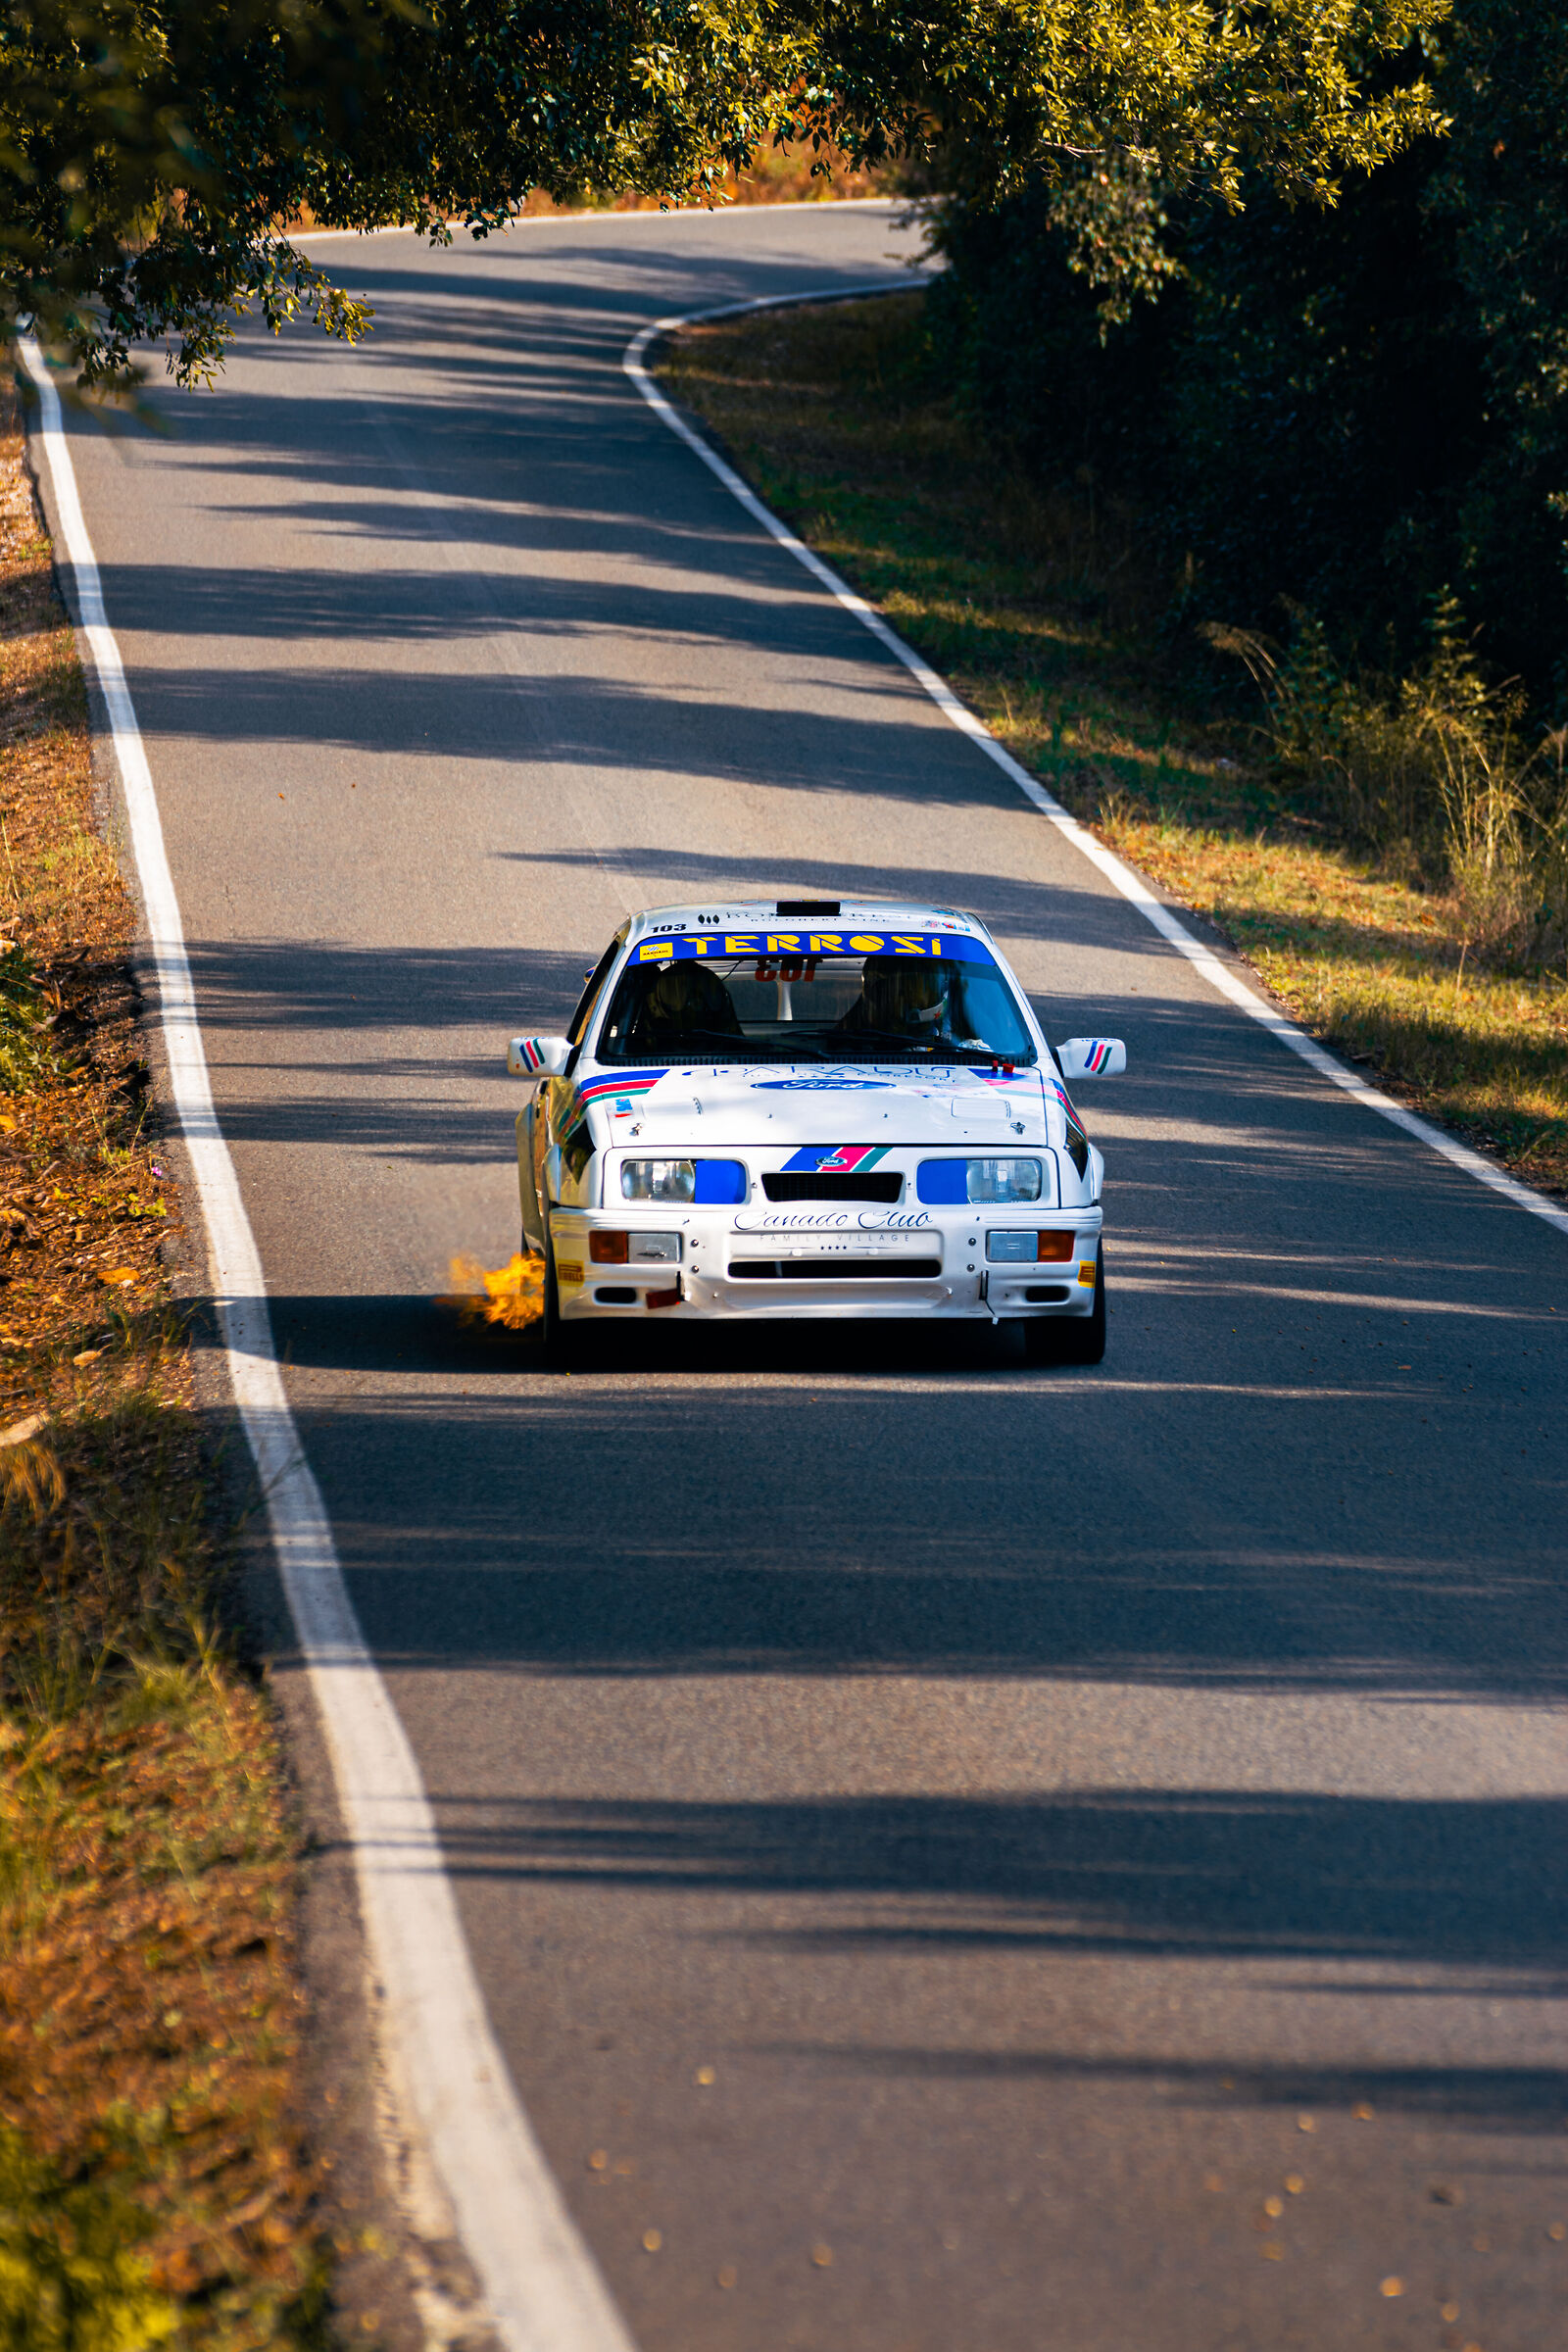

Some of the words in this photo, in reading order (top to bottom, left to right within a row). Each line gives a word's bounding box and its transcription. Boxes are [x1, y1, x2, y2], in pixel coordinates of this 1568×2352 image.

[651, 923, 687, 933] 103
[682, 934, 941, 956] TERROSI
[782, 1079, 866, 1089] Ford
[821, 1155, 840, 1164] Ford
